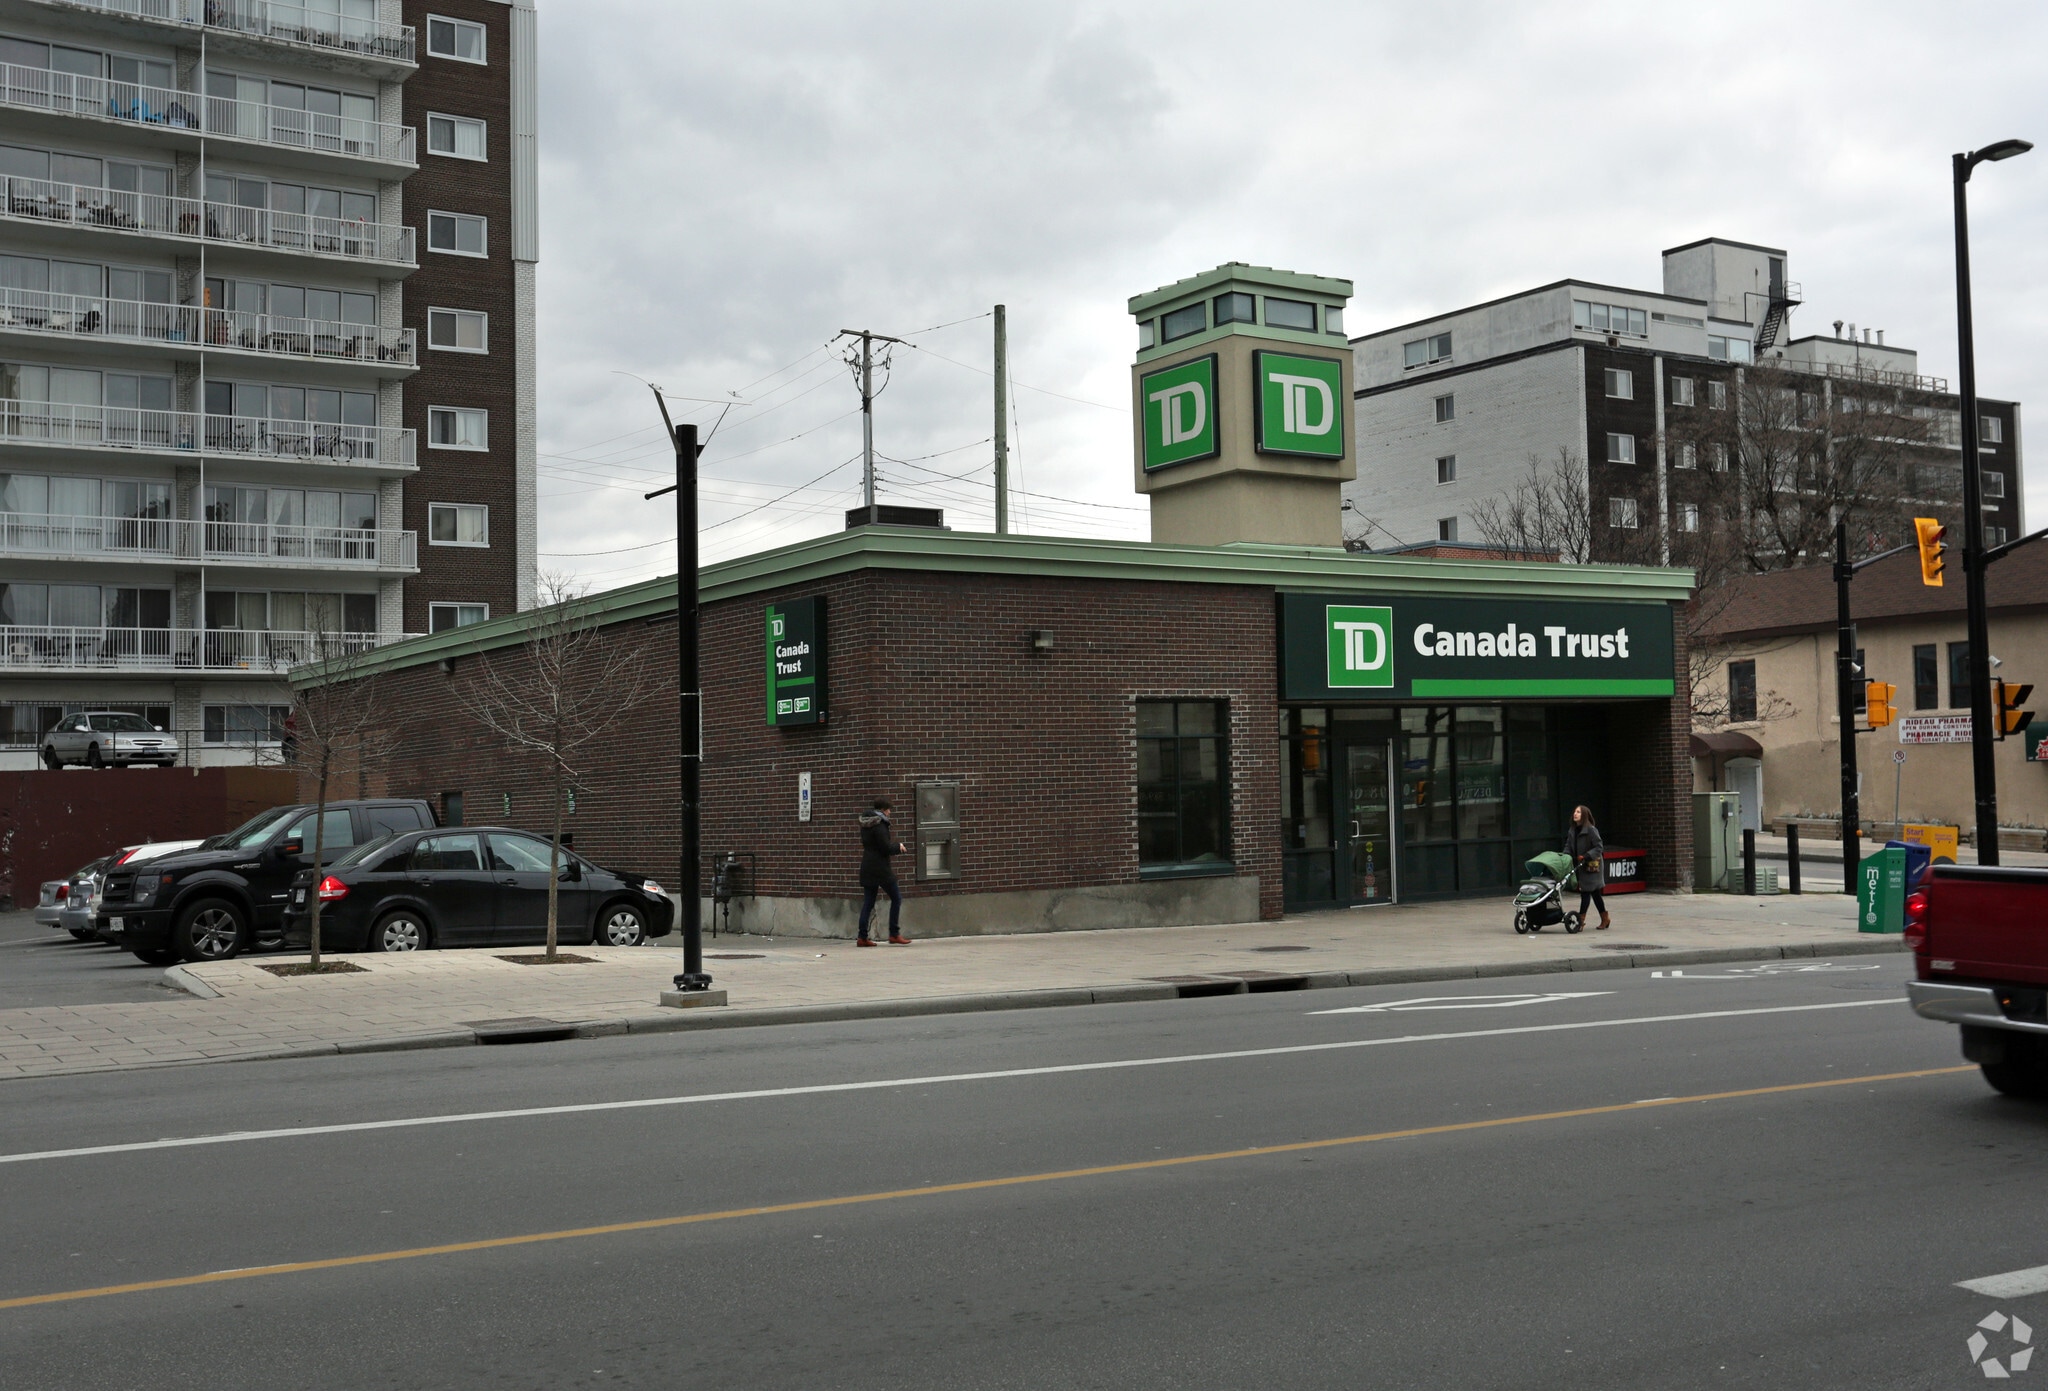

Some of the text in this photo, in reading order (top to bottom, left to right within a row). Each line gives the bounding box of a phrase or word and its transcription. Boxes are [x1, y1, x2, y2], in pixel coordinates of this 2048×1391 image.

[1268, 372, 1334, 436] TD
[1149, 381, 1206, 447] TD
[771, 618, 783, 637] TD
[776, 640, 810, 658] Canada
[1333, 621, 1630, 671] TD Canada Trust
[776, 659, 802, 675] Trust
[1906, 828, 1925, 837] Start
